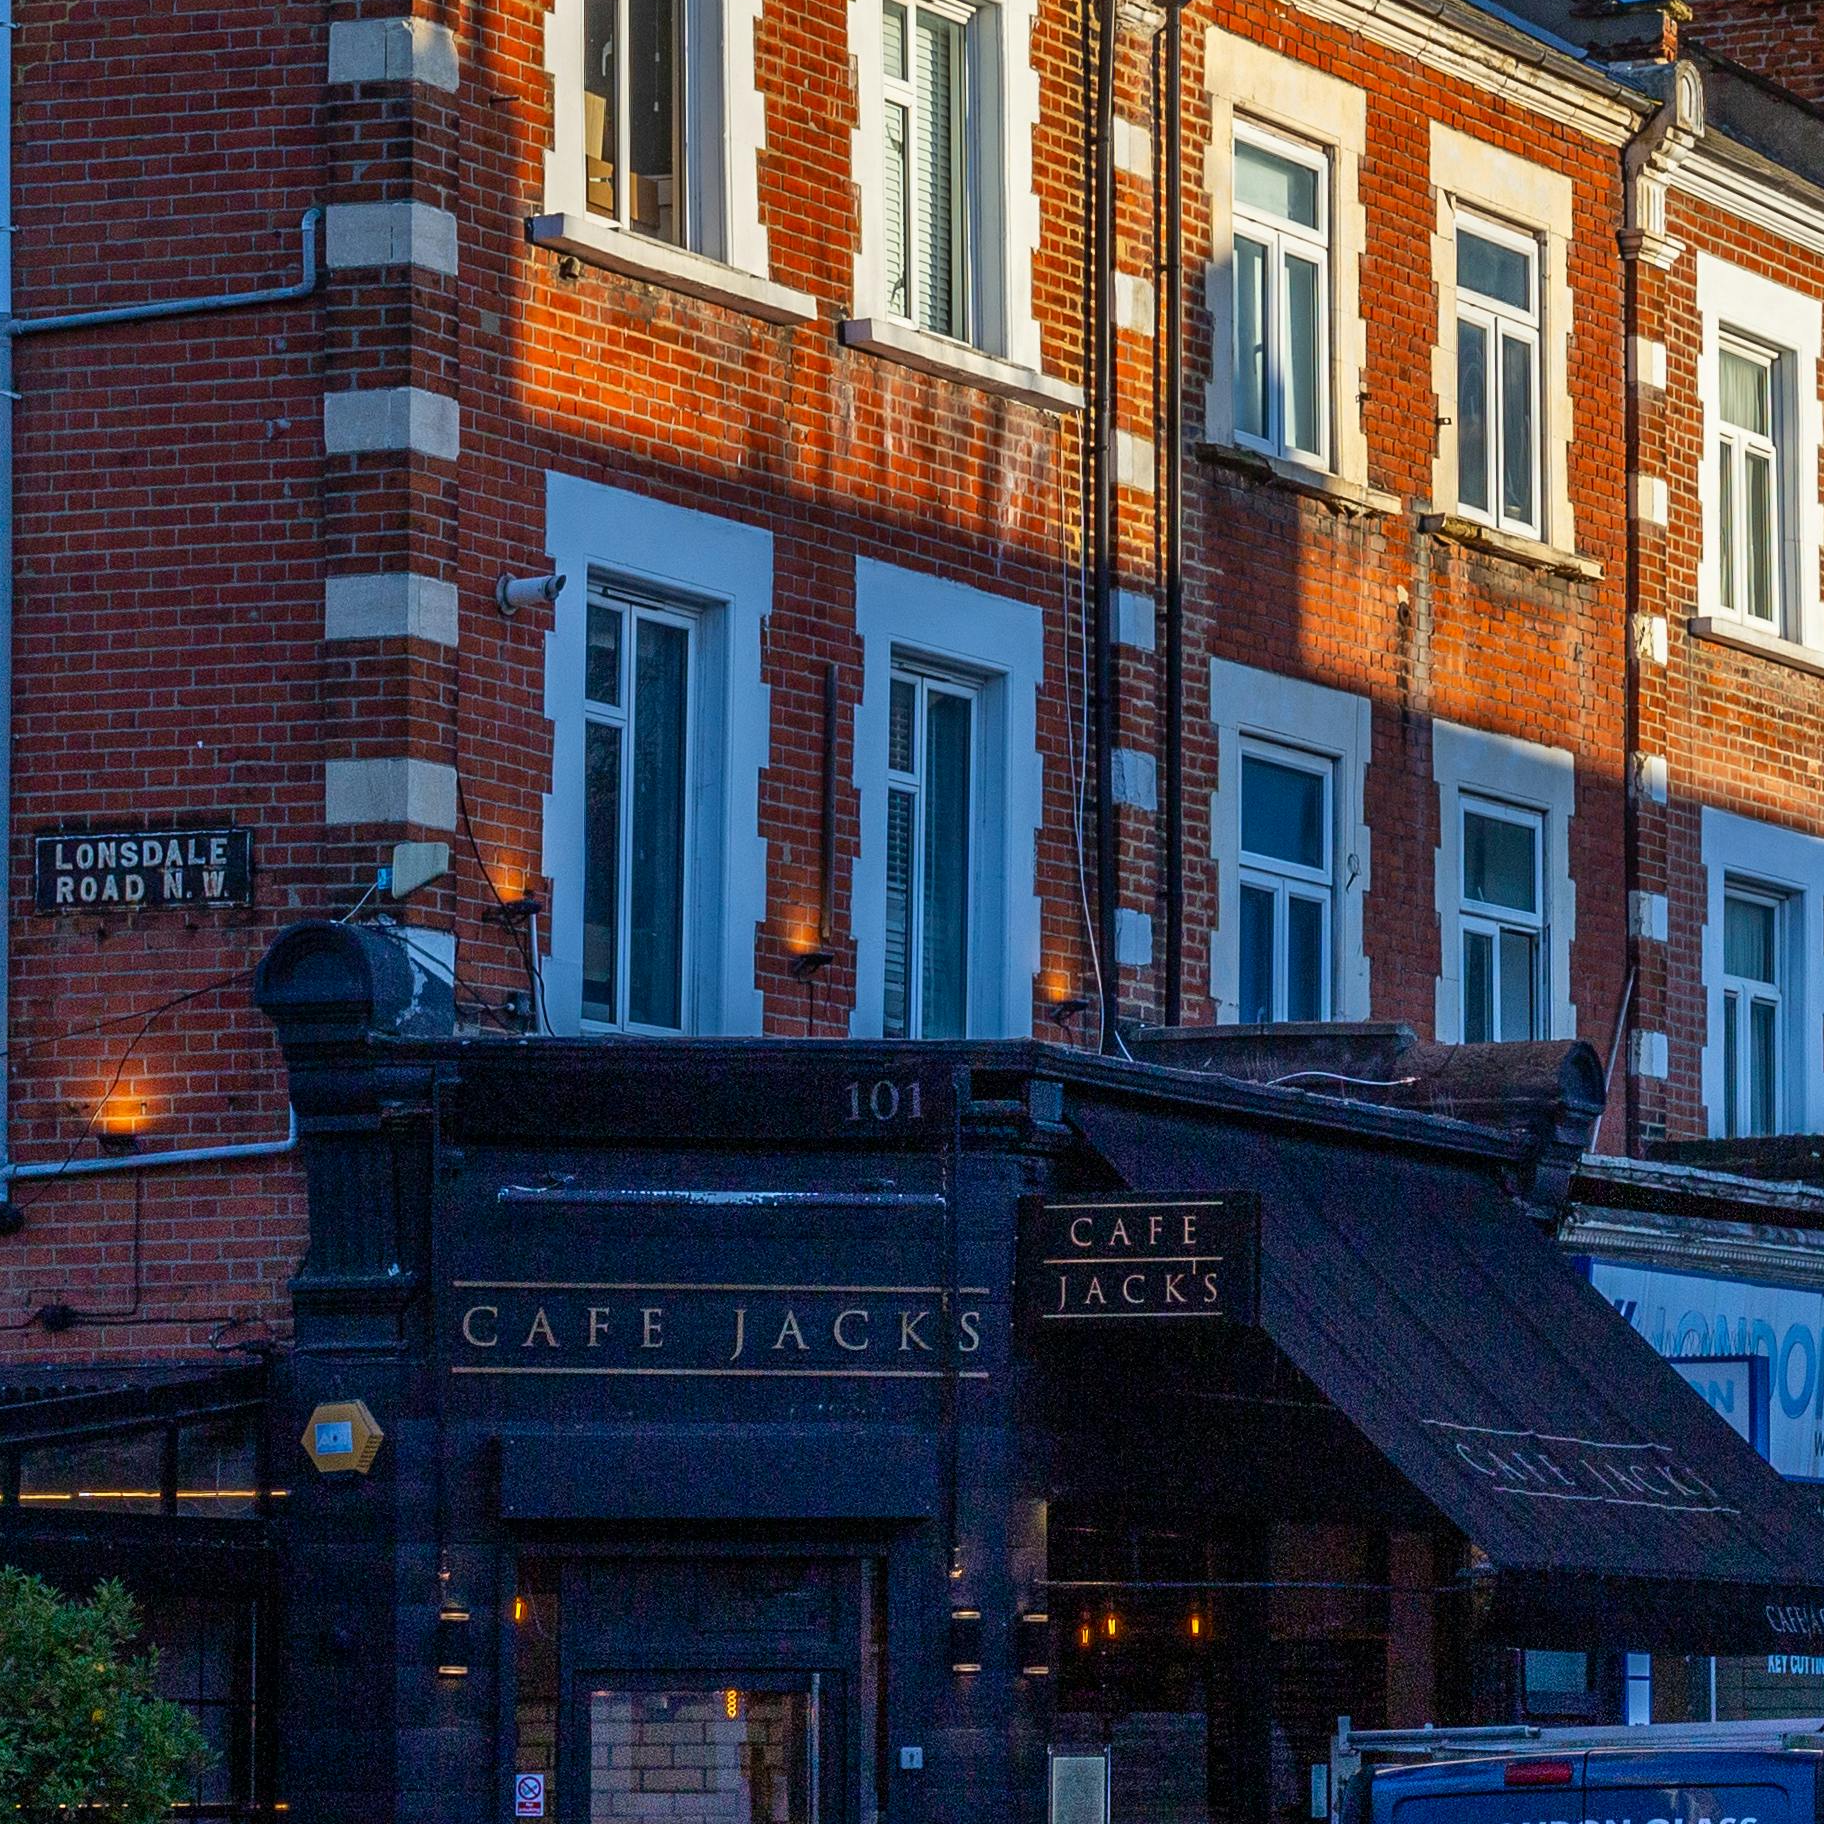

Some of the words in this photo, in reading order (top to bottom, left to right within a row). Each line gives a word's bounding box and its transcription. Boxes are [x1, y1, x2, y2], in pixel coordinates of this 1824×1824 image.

[56, 837, 229, 871] LONSDALE
[56, 874, 146, 905] ROAD
[845, 1080, 924, 1121] 101
[1071, 1214, 1199, 1248] CAFE
[462, 1304, 665, 1349] CAFE
[1456, 1443, 1576, 1486] CAFE
[1765, 1605, 1808, 1634] CAFE
